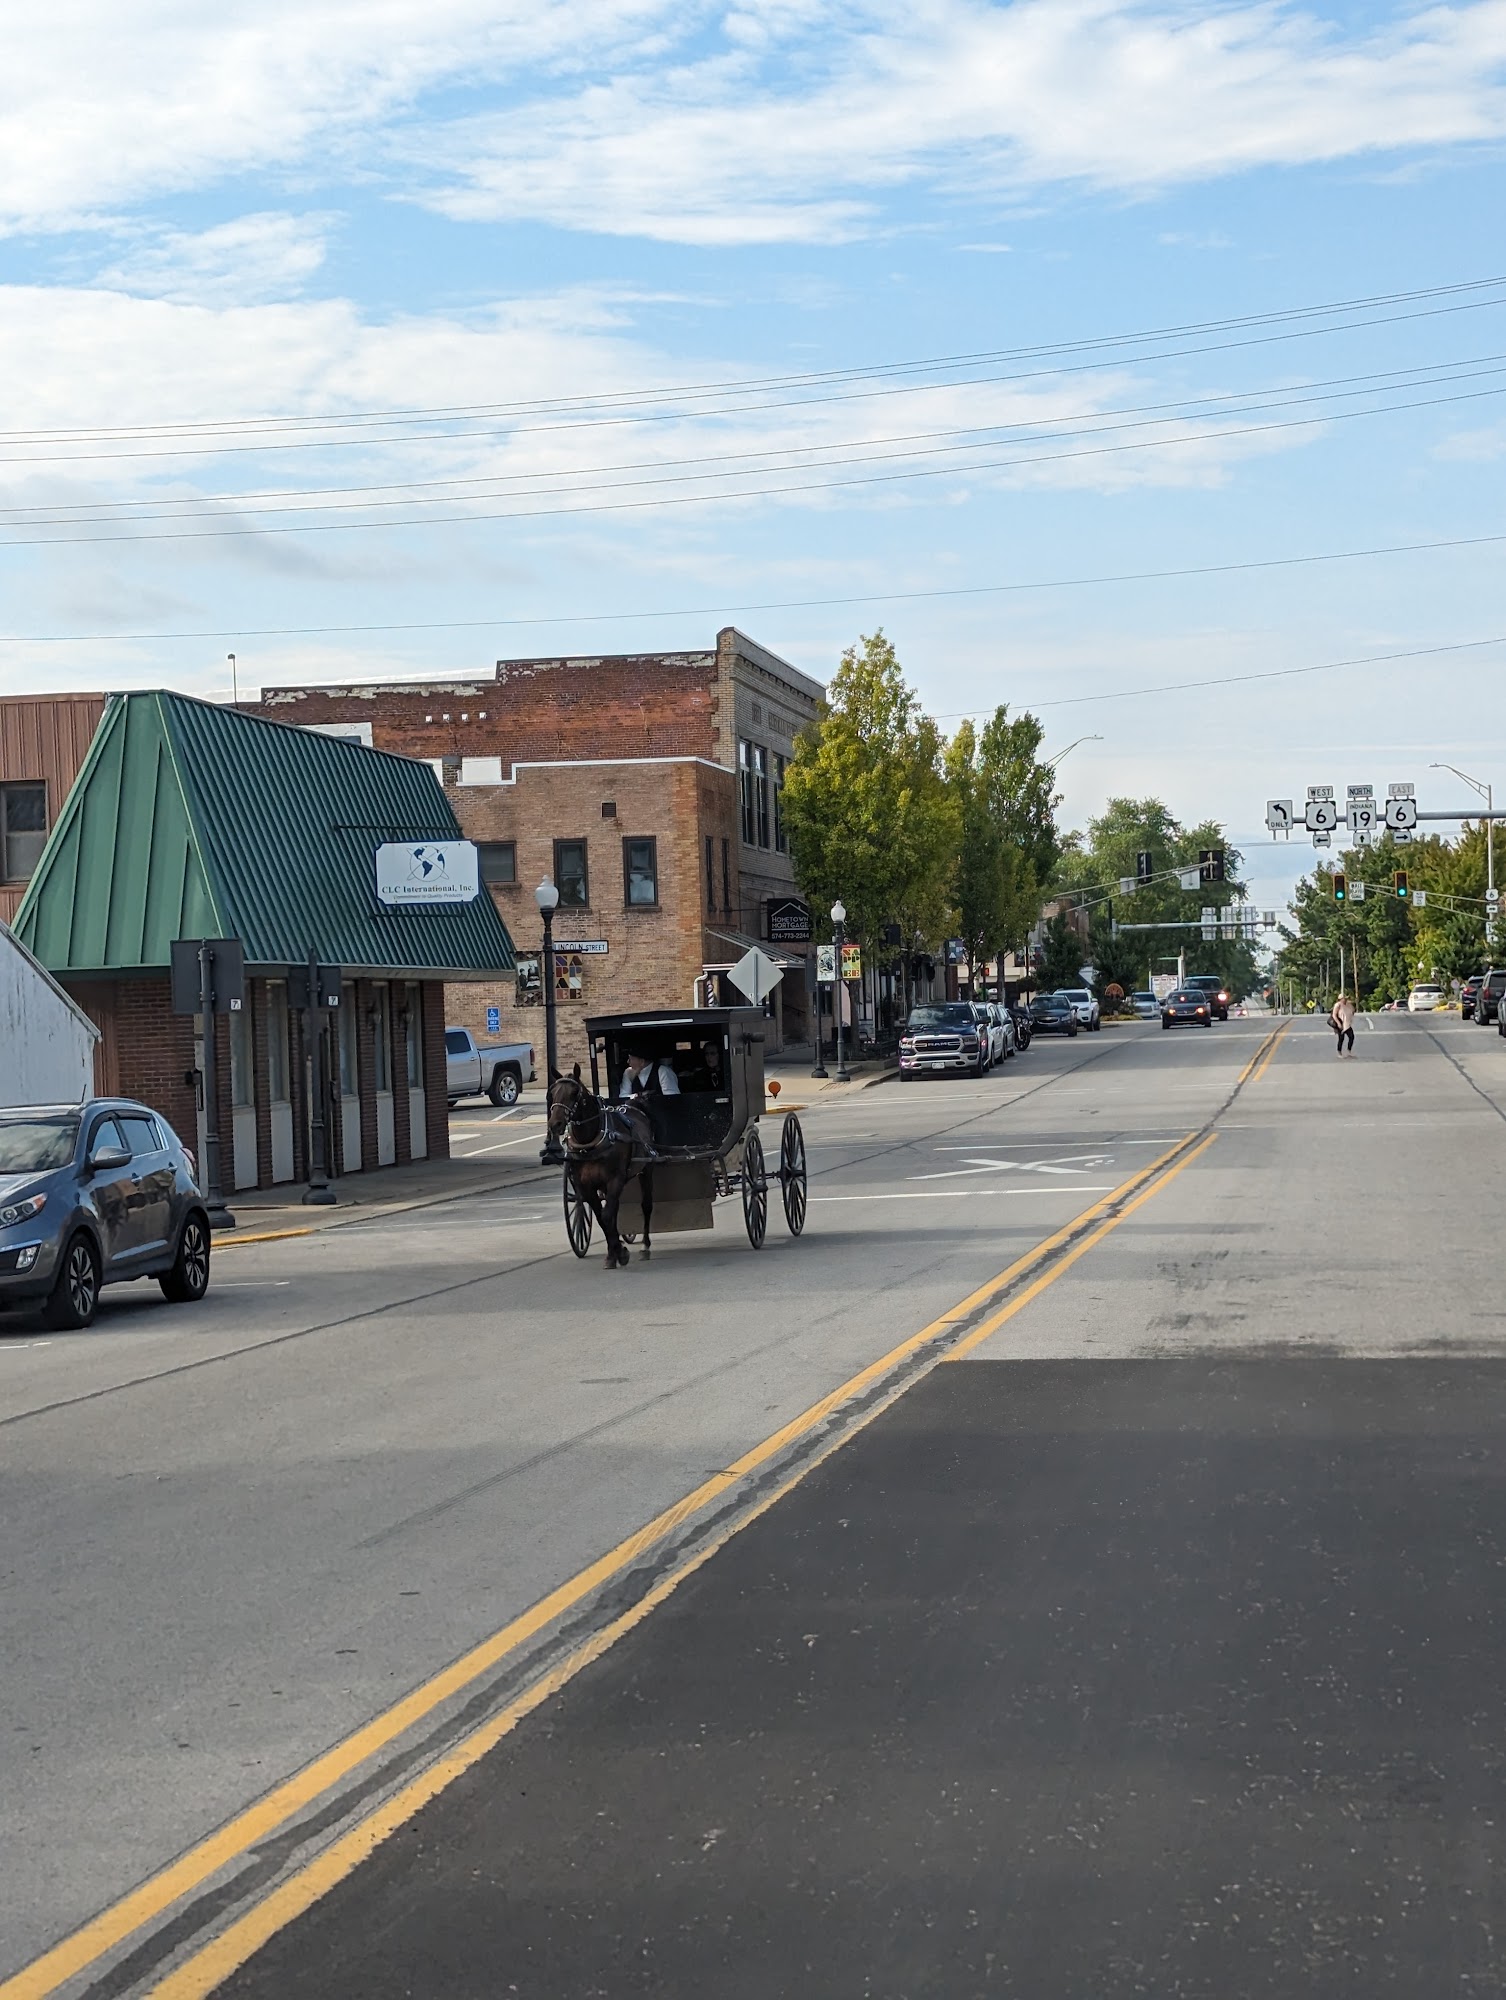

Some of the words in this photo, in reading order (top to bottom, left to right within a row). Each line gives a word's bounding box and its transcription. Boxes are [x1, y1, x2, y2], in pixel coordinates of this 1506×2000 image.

[1349, 787, 1372, 796] NORTH
[1391, 785, 1411, 794] EAST
[1316, 808, 1326, 824] 6
[1352, 811, 1371, 827] 19
[1396, 806, 1406, 821] 6
[403, 885, 458, 893] International,
[460, 884, 475, 892] Inc.
